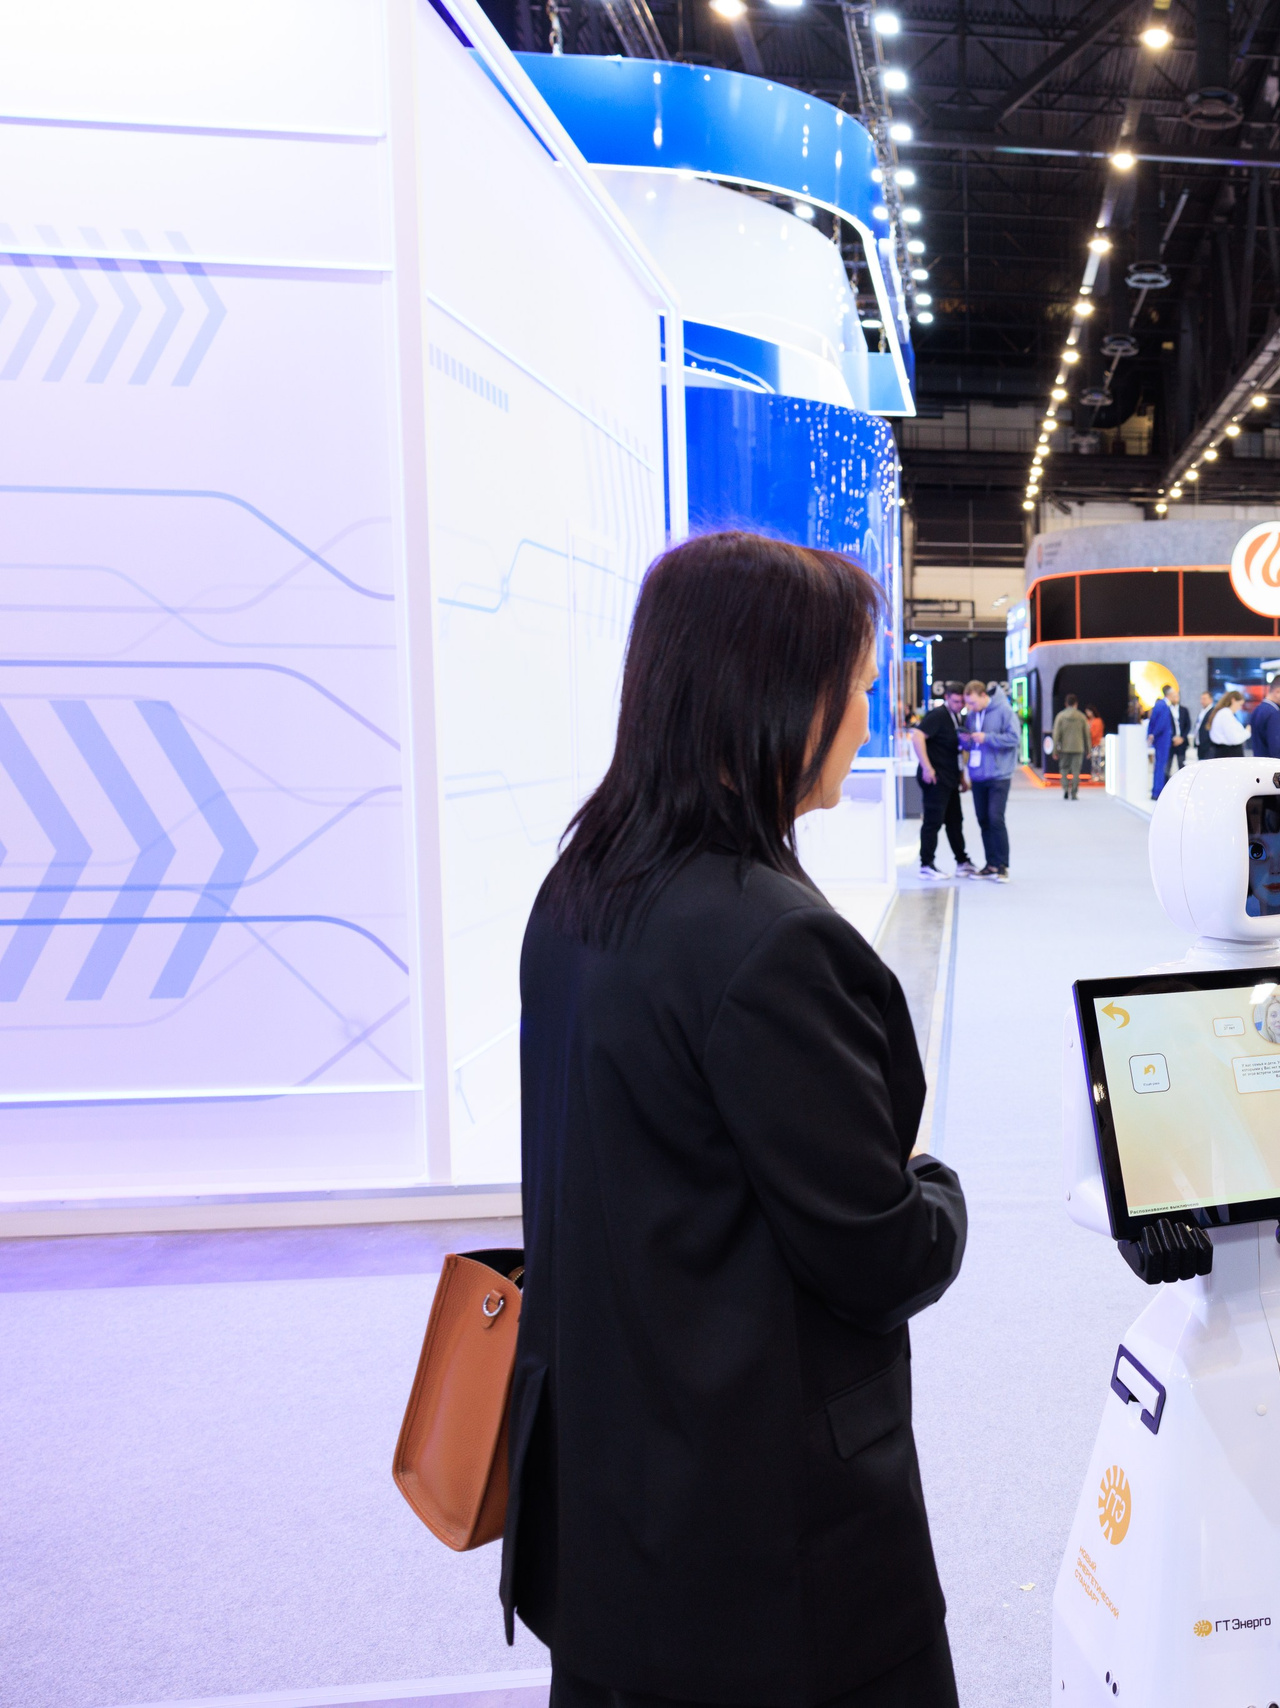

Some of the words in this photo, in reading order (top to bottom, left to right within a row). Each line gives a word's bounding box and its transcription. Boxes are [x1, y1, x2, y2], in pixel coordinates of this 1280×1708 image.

[1129, 1206, 1169, 1215] Распознавание
[1169, 1202, 1200, 1210] выключено
[1079, 1545, 1097, 1573] НОВЫЙ
[1074, 1568, 1099, 1607] СТАНДАРТ
[1077, 1556, 1119, 1620] ЭНЕРГЕТИЧЕСКИЙ
